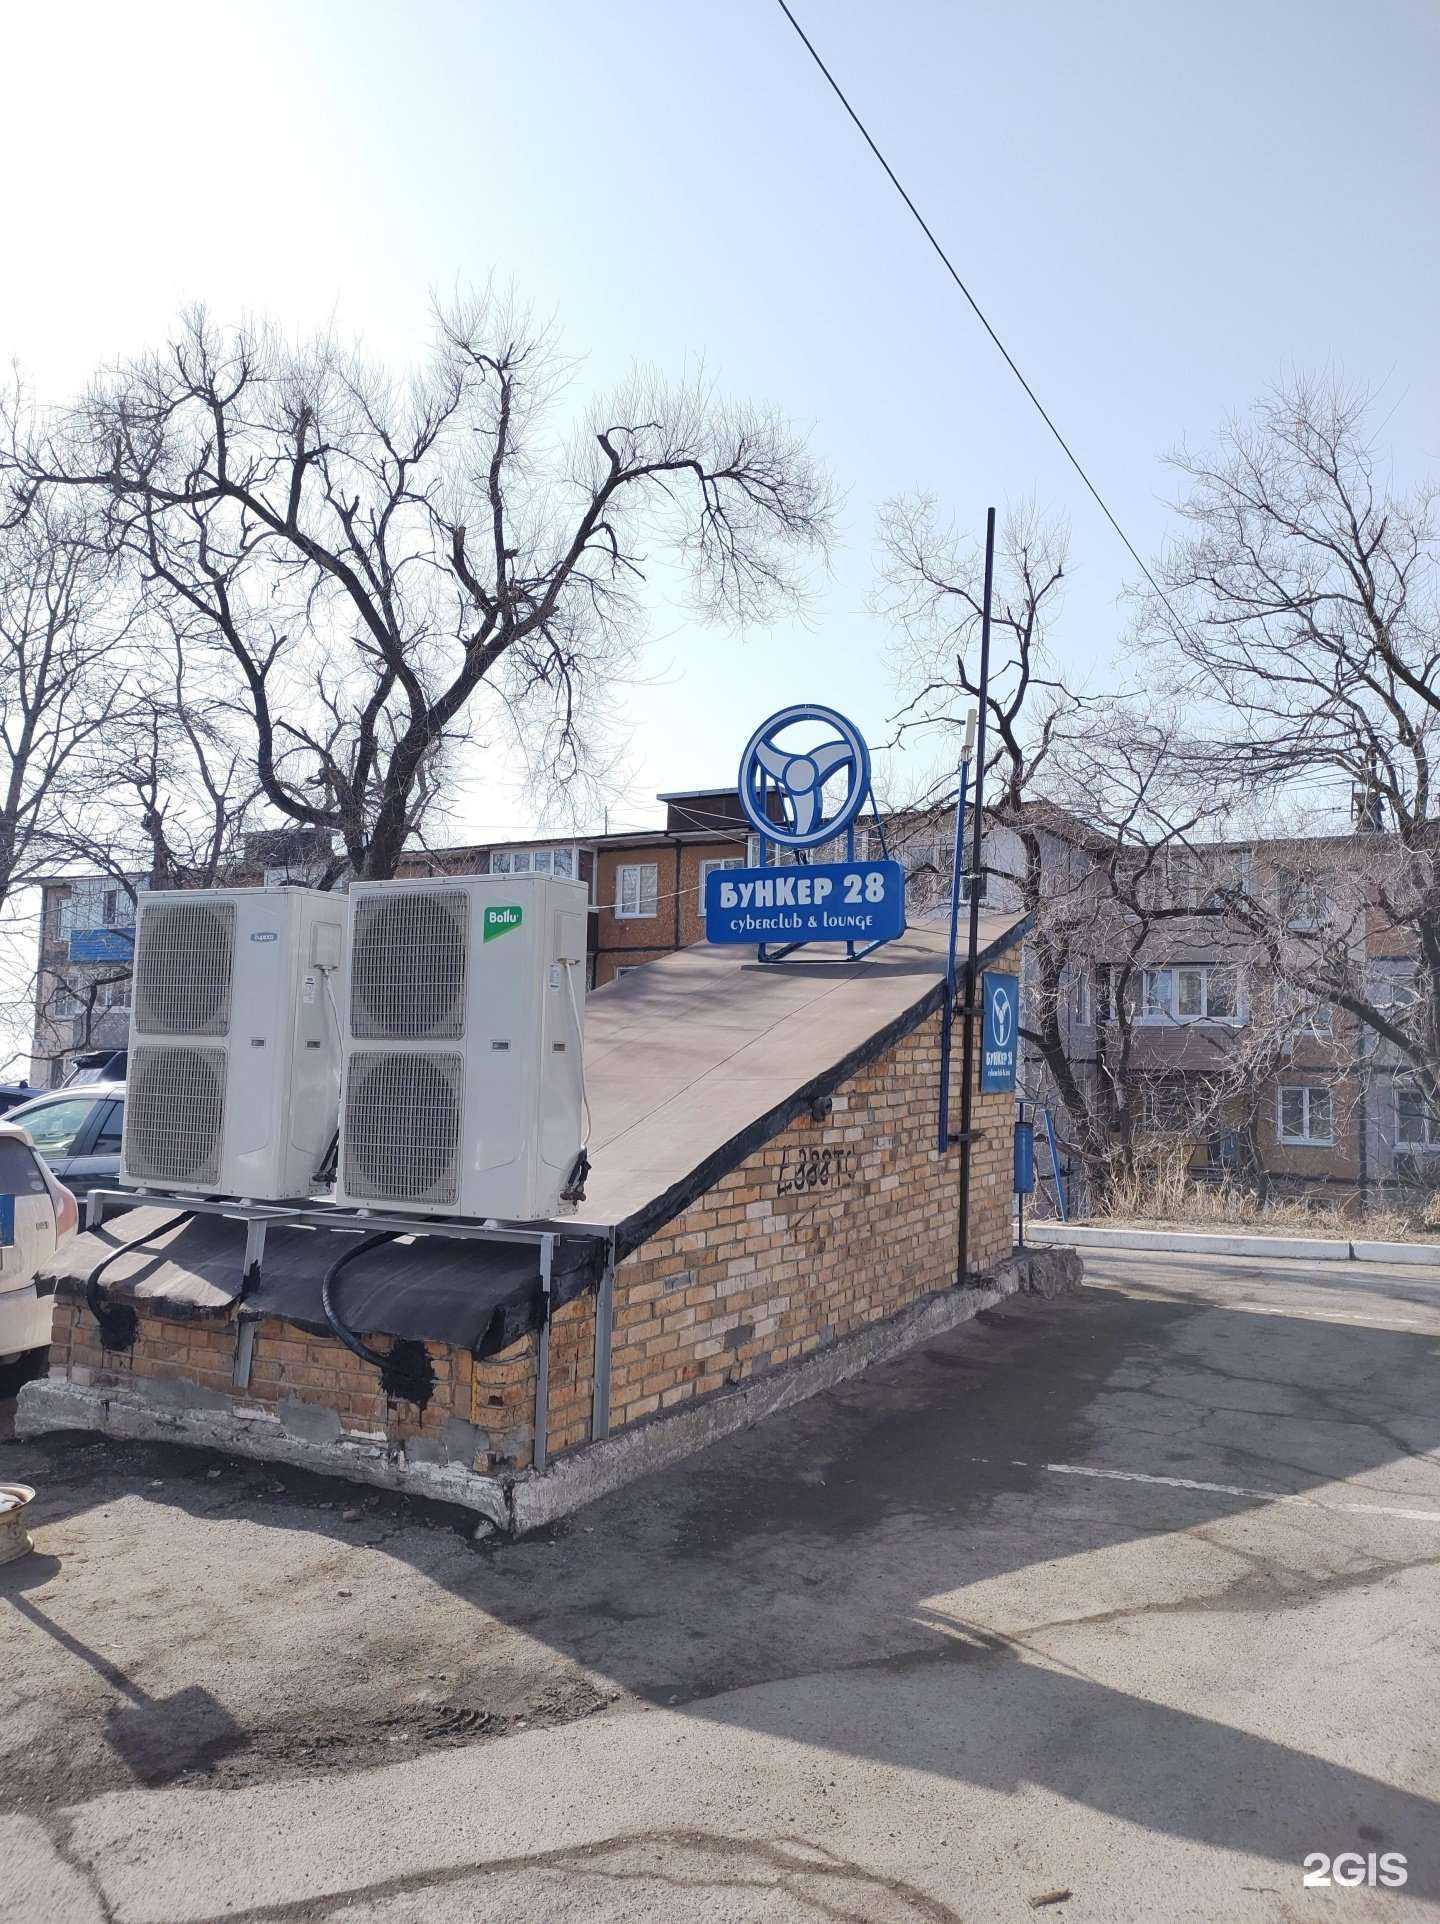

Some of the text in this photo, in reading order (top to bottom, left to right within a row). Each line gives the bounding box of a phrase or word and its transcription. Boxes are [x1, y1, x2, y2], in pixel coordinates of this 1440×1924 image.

[720, 872, 885, 909] БУНКЕР 28
[730, 913, 802, 933] cyberclub
[808, 915, 818, 928] &
